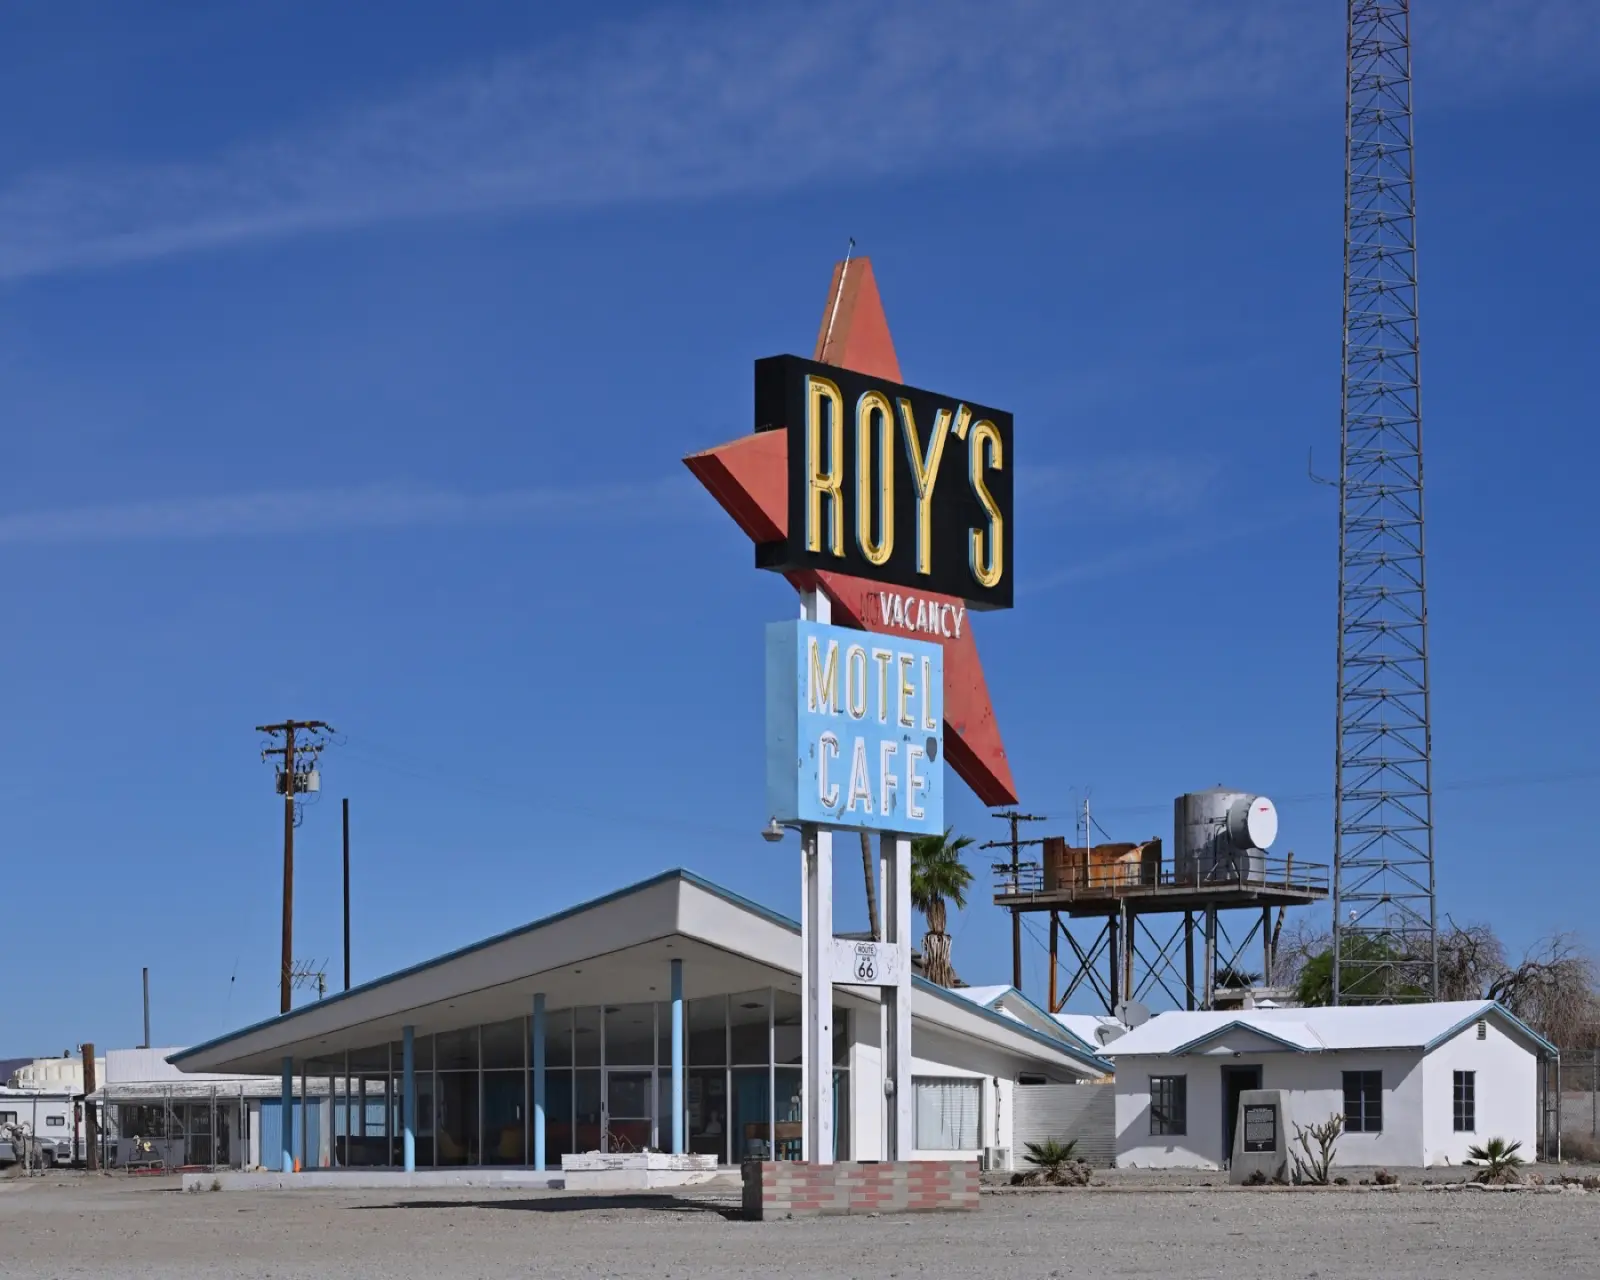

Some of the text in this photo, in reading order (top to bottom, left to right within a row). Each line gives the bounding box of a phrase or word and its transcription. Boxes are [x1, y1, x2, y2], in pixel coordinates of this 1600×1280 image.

[805, 374, 1002, 588] ROY'S
[880, 591, 965, 639] VACANCY
[808, 636, 937, 732] MOTEL
[819, 731, 925, 820] CAFE
[857, 946, 874, 954] ROUTE
[858, 962, 874, 978] 66
